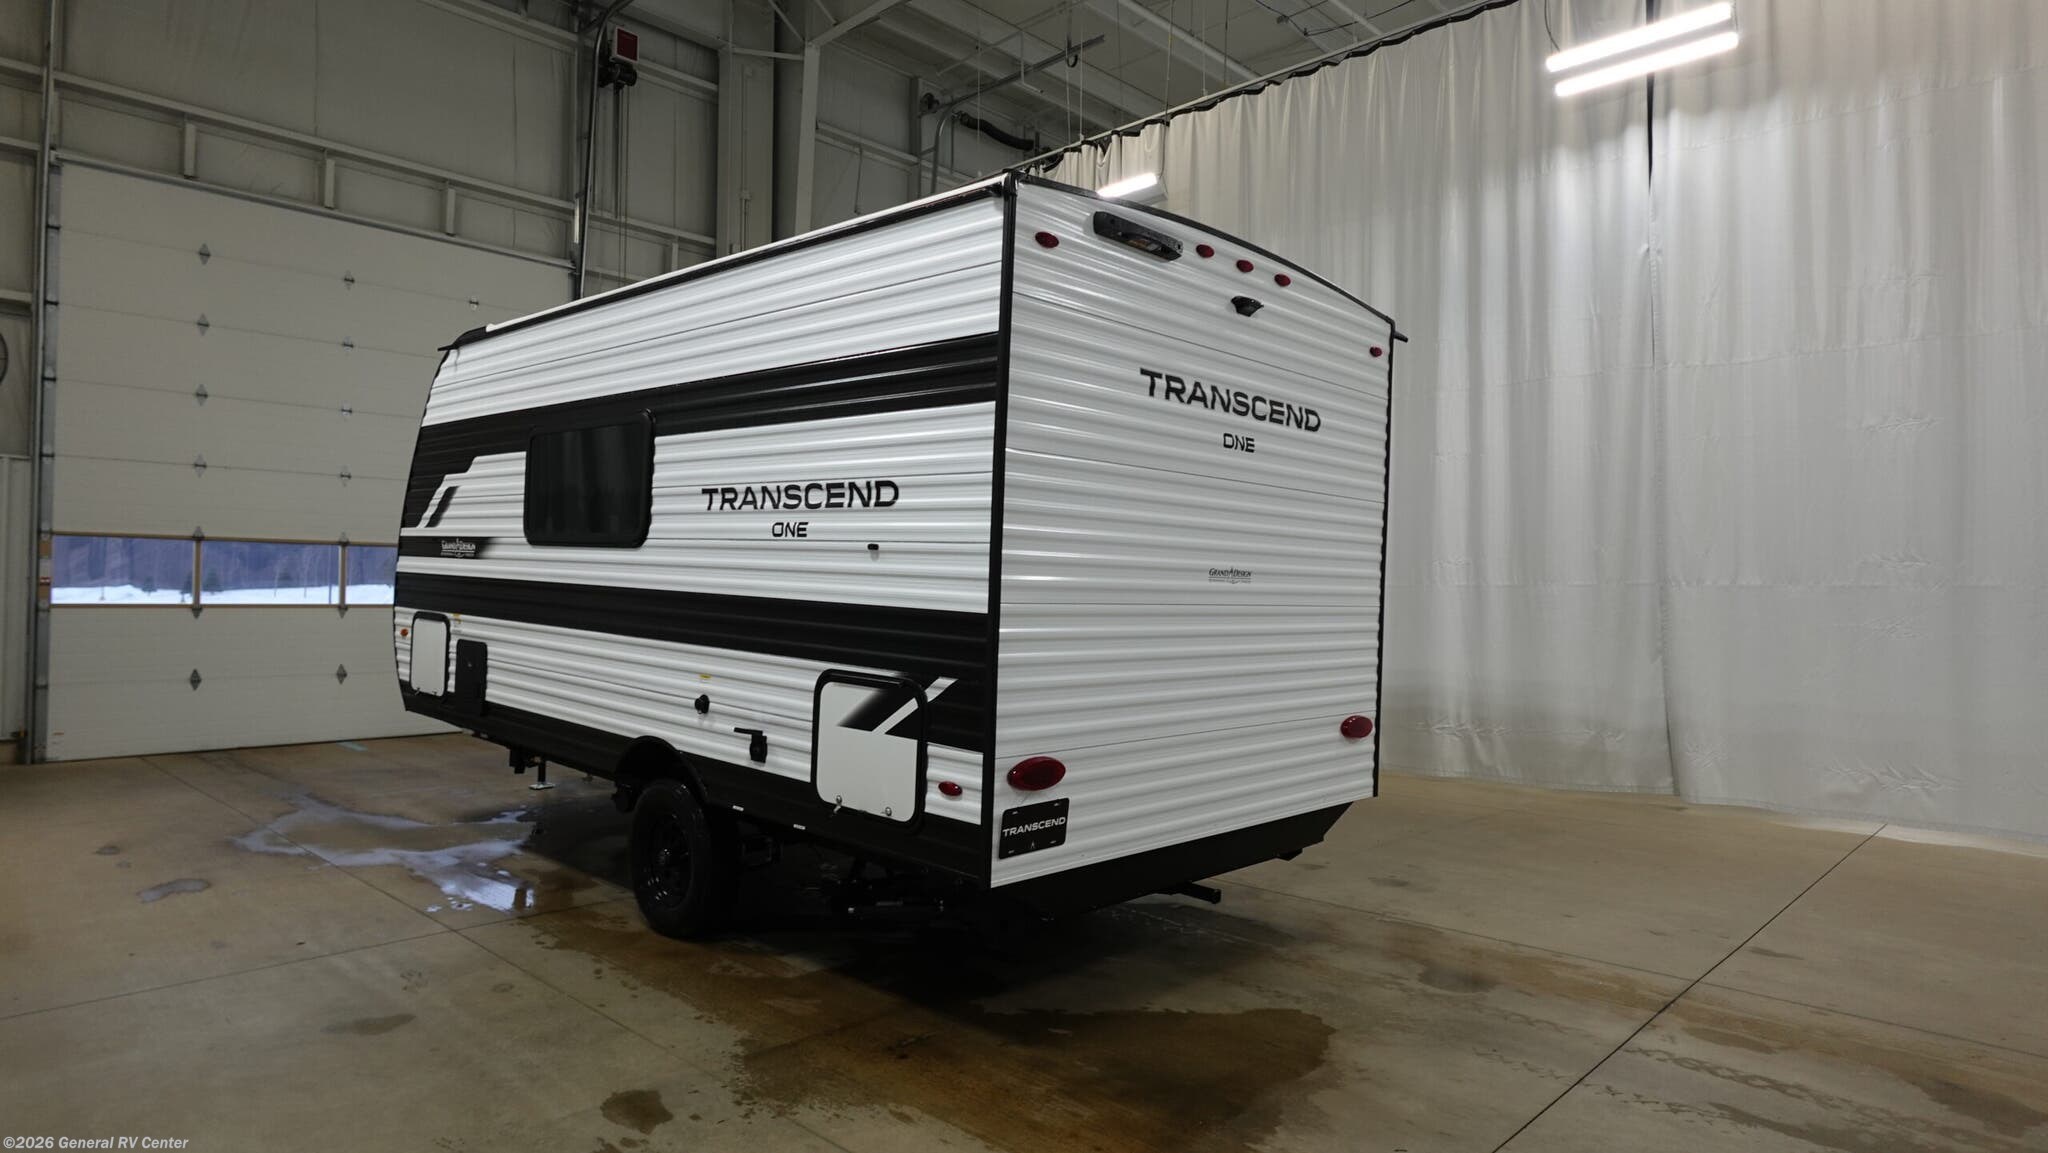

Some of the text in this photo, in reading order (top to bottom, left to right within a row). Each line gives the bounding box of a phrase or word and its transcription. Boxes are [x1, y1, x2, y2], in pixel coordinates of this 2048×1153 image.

[1139, 368, 1321, 433] TRANSCEND
[1222, 432, 1255, 454] ONE
[701, 480, 899, 511] TRANSCEND
[771, 521, 808, 538] ONE
[1003, 817, 1065, 836] TRANSCEND
